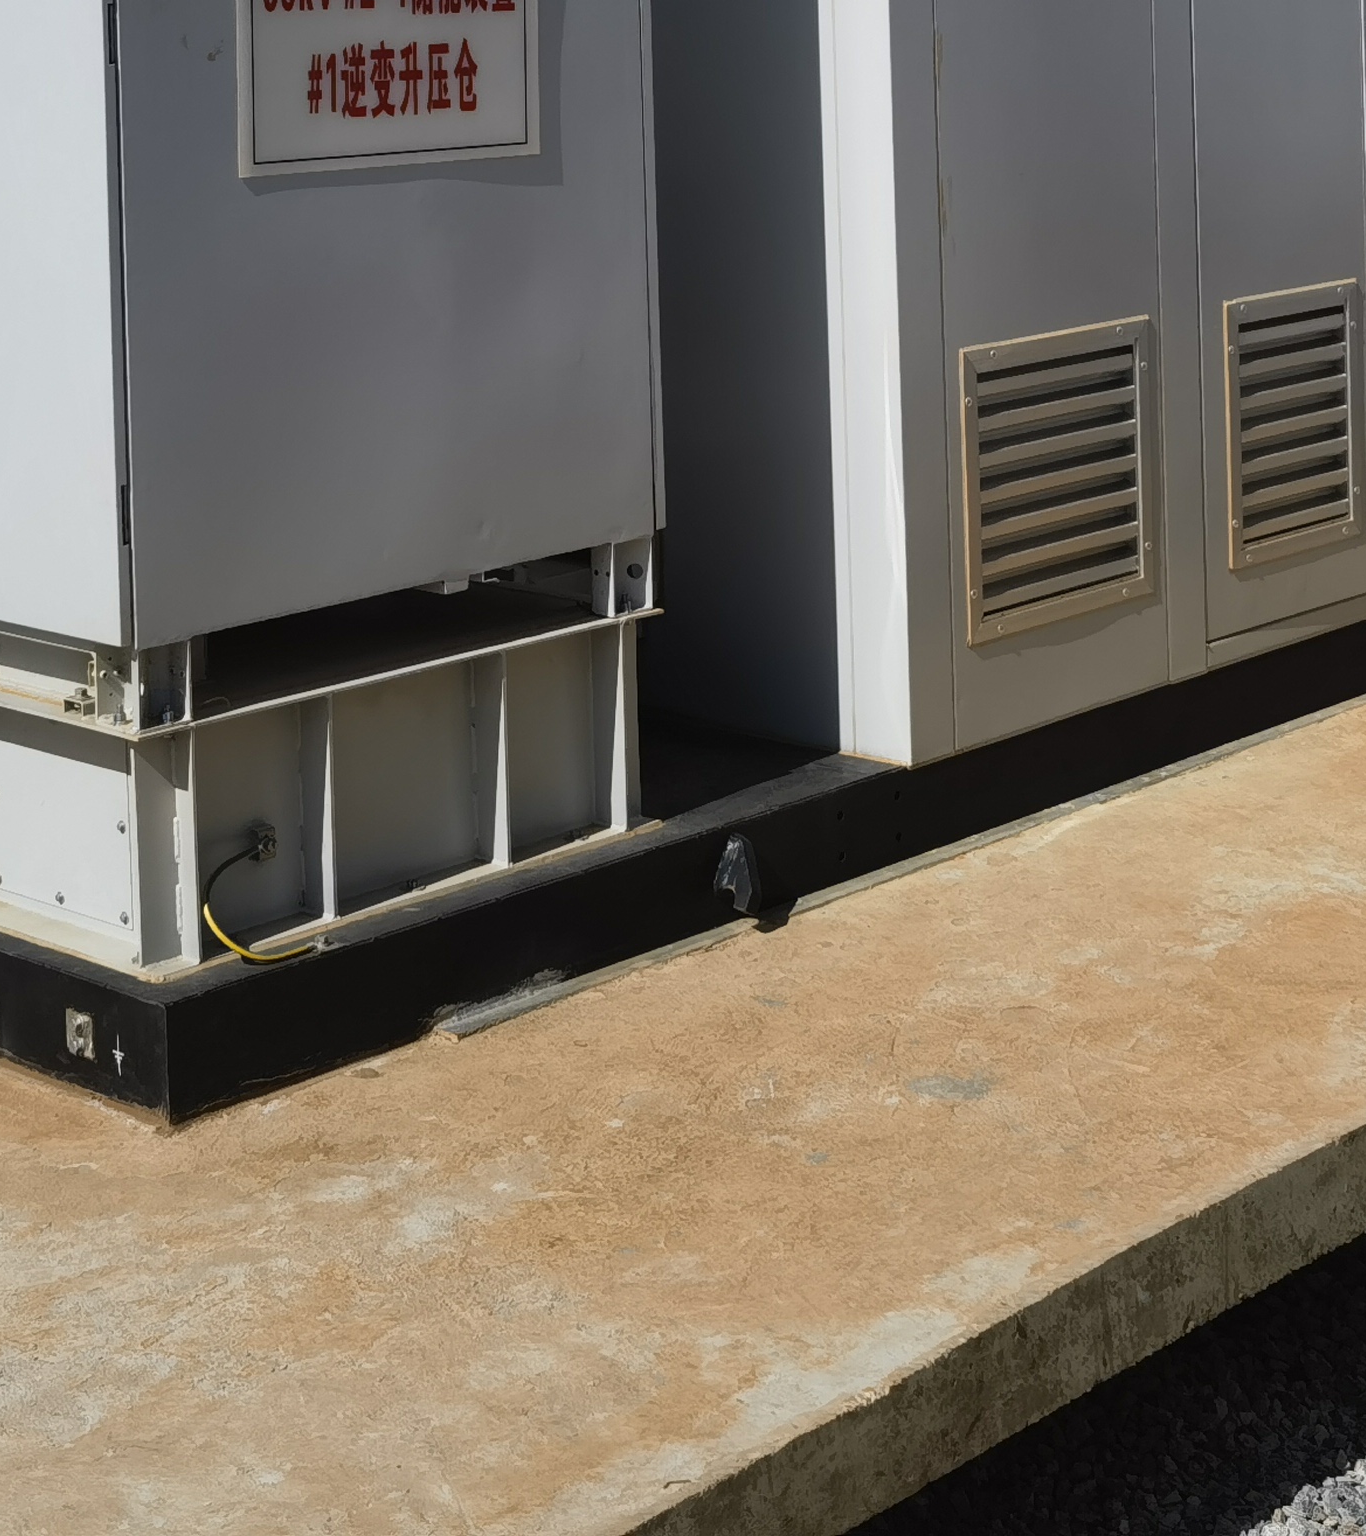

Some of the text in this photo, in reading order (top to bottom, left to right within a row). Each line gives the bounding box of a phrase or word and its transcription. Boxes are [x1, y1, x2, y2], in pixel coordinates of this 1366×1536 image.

[307, 38, 478, 118] #1逆变升压仓
